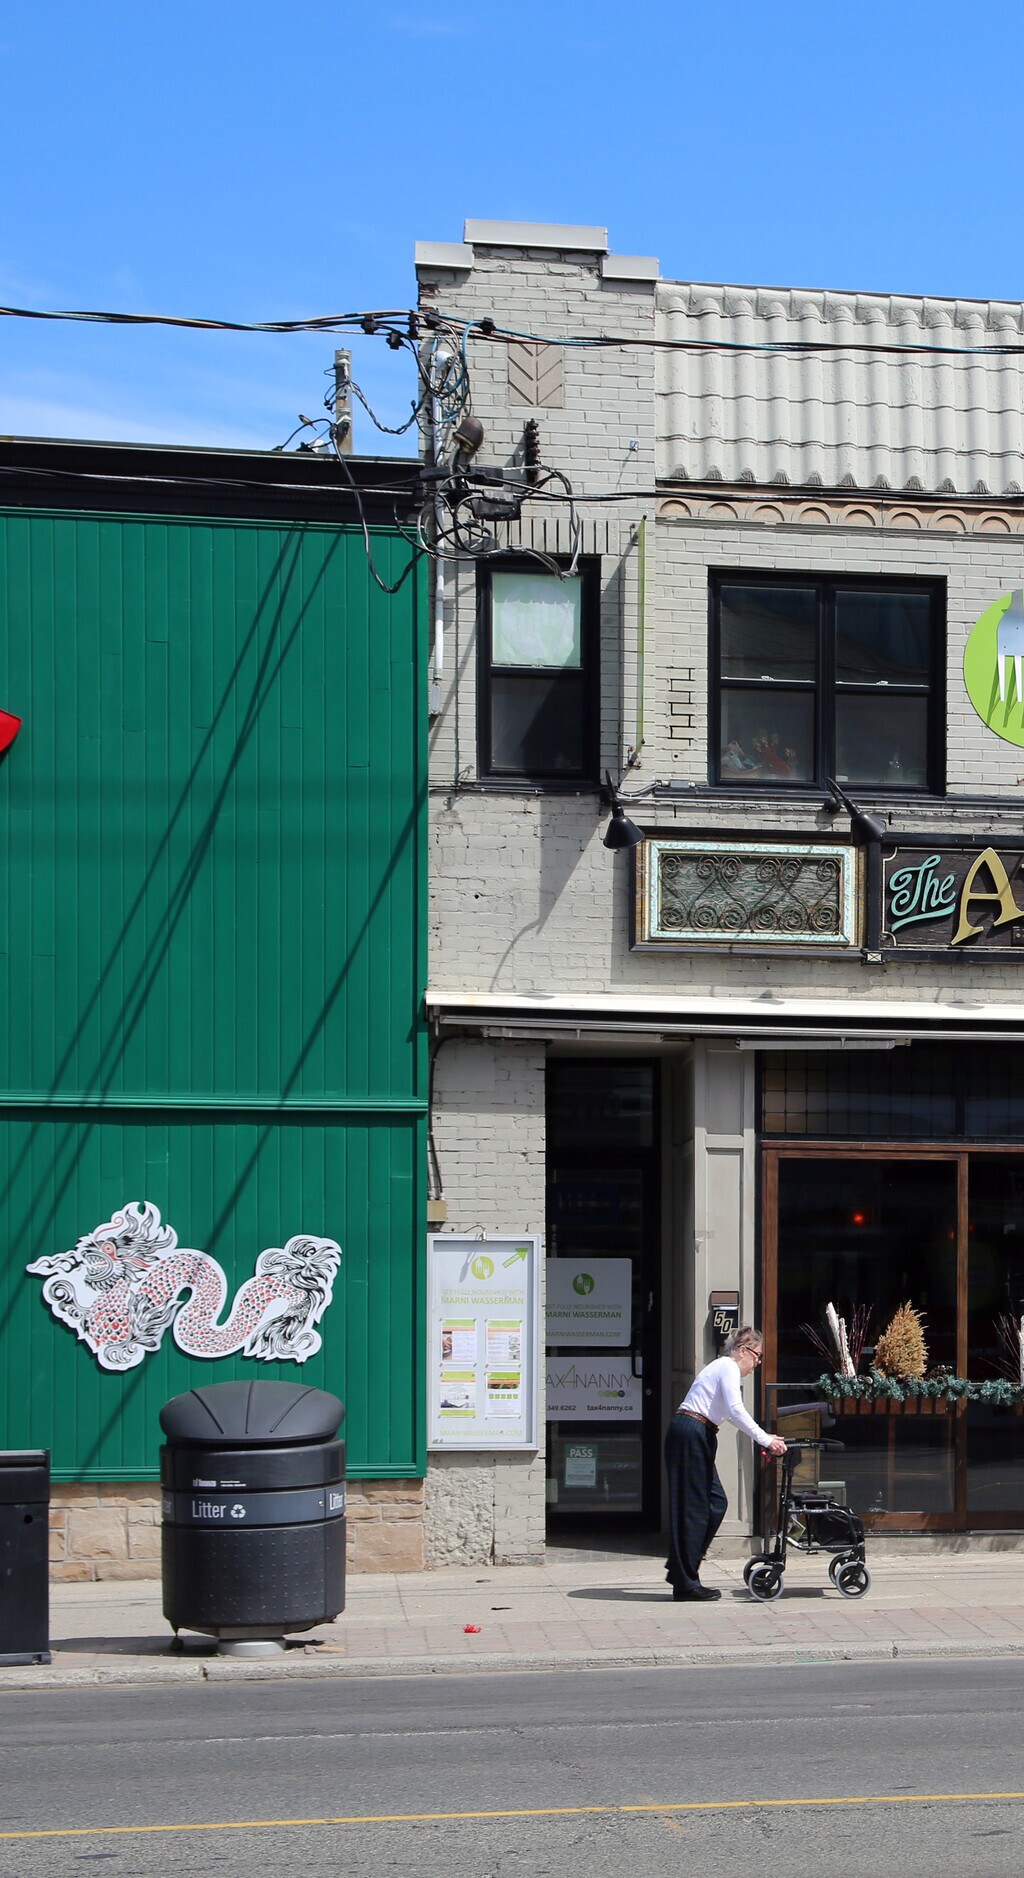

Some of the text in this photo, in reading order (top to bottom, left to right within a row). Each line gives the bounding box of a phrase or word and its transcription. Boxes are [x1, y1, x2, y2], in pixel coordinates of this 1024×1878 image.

[889, 853, 958, 919] The
[441, 1297, 524, 1305] MARNI WASSERMAN
[573, 1311, 622, 1319] WASSERMAN
[546, 1364, 633, 1389] AX4NANNY
[587, 1404, 634, 1413] tax4nanny.ca
[570, 1448, 593, 1458] PASS
[191, 1500, 227, 1519] Litter
